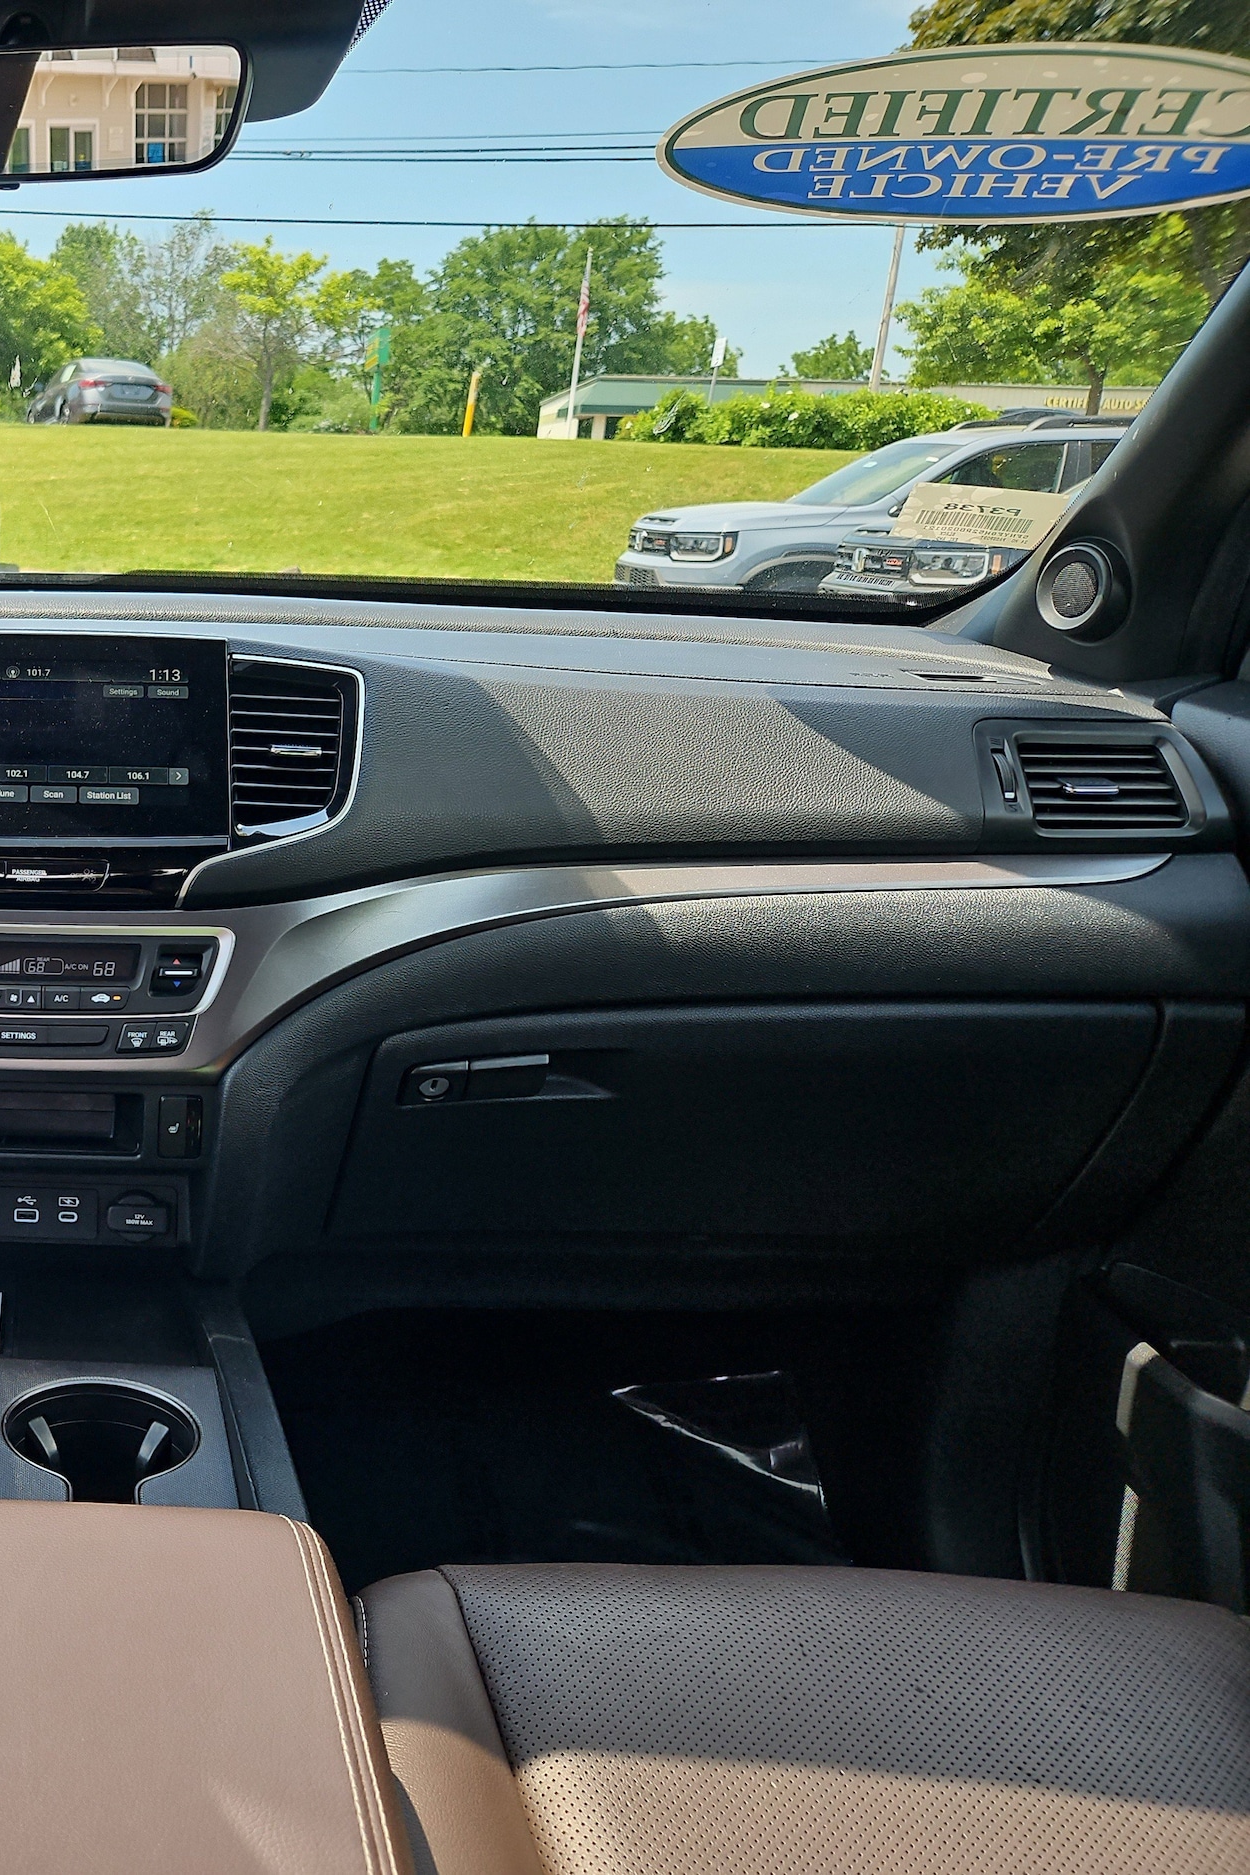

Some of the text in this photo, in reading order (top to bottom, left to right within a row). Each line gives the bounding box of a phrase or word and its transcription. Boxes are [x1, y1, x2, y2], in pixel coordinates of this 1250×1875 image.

[1101, 397, 1133, 410] AUTO
[26, 668, 51, 677] 101.7
[149, 668, 181, 682] 1:13
[109, 687, 138, 697] Settings
[156, 688, 180, 696] Sound
[5, 769, 28, 778] 102.1
[65, 770, 90, 779] 104.7
[127, 771, 150, 780] 106.1
[43, 790, 64, 799] Scan
[86, 791, 132, 800] Station List
[27, 961, 46, 973] 68
[64, 963, 89, 971] A/C ON
[92, 961, 116, 977] 68
[53, 994, 69, 1002] A/C
[0, 1031, 37, 1040] SETTINGS
